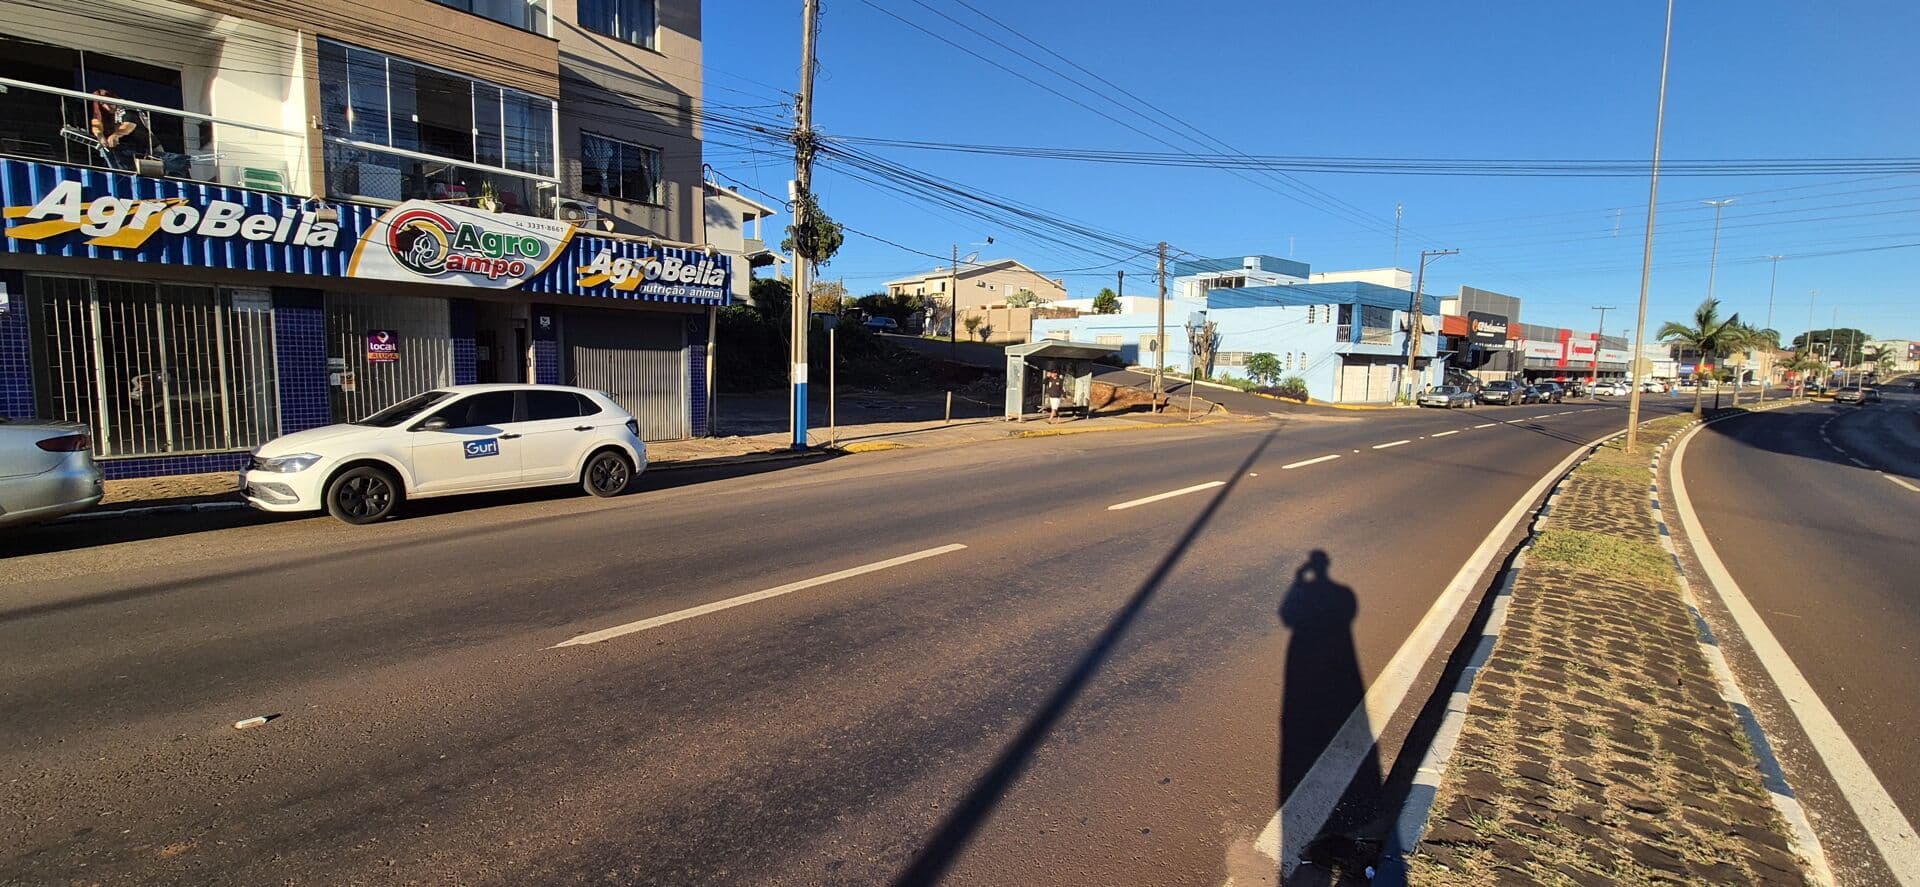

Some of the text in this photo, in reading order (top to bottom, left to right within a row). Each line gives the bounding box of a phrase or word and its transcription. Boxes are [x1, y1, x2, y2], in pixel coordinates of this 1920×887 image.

[27, 180, 339, 248] AgroBella
[453, 222, 541, 259] Agro
[588, 248, 726, 287] AgroBella
[640, 284, 723, 299] nutrição animal
[467, 441, 497, 454] Guri
